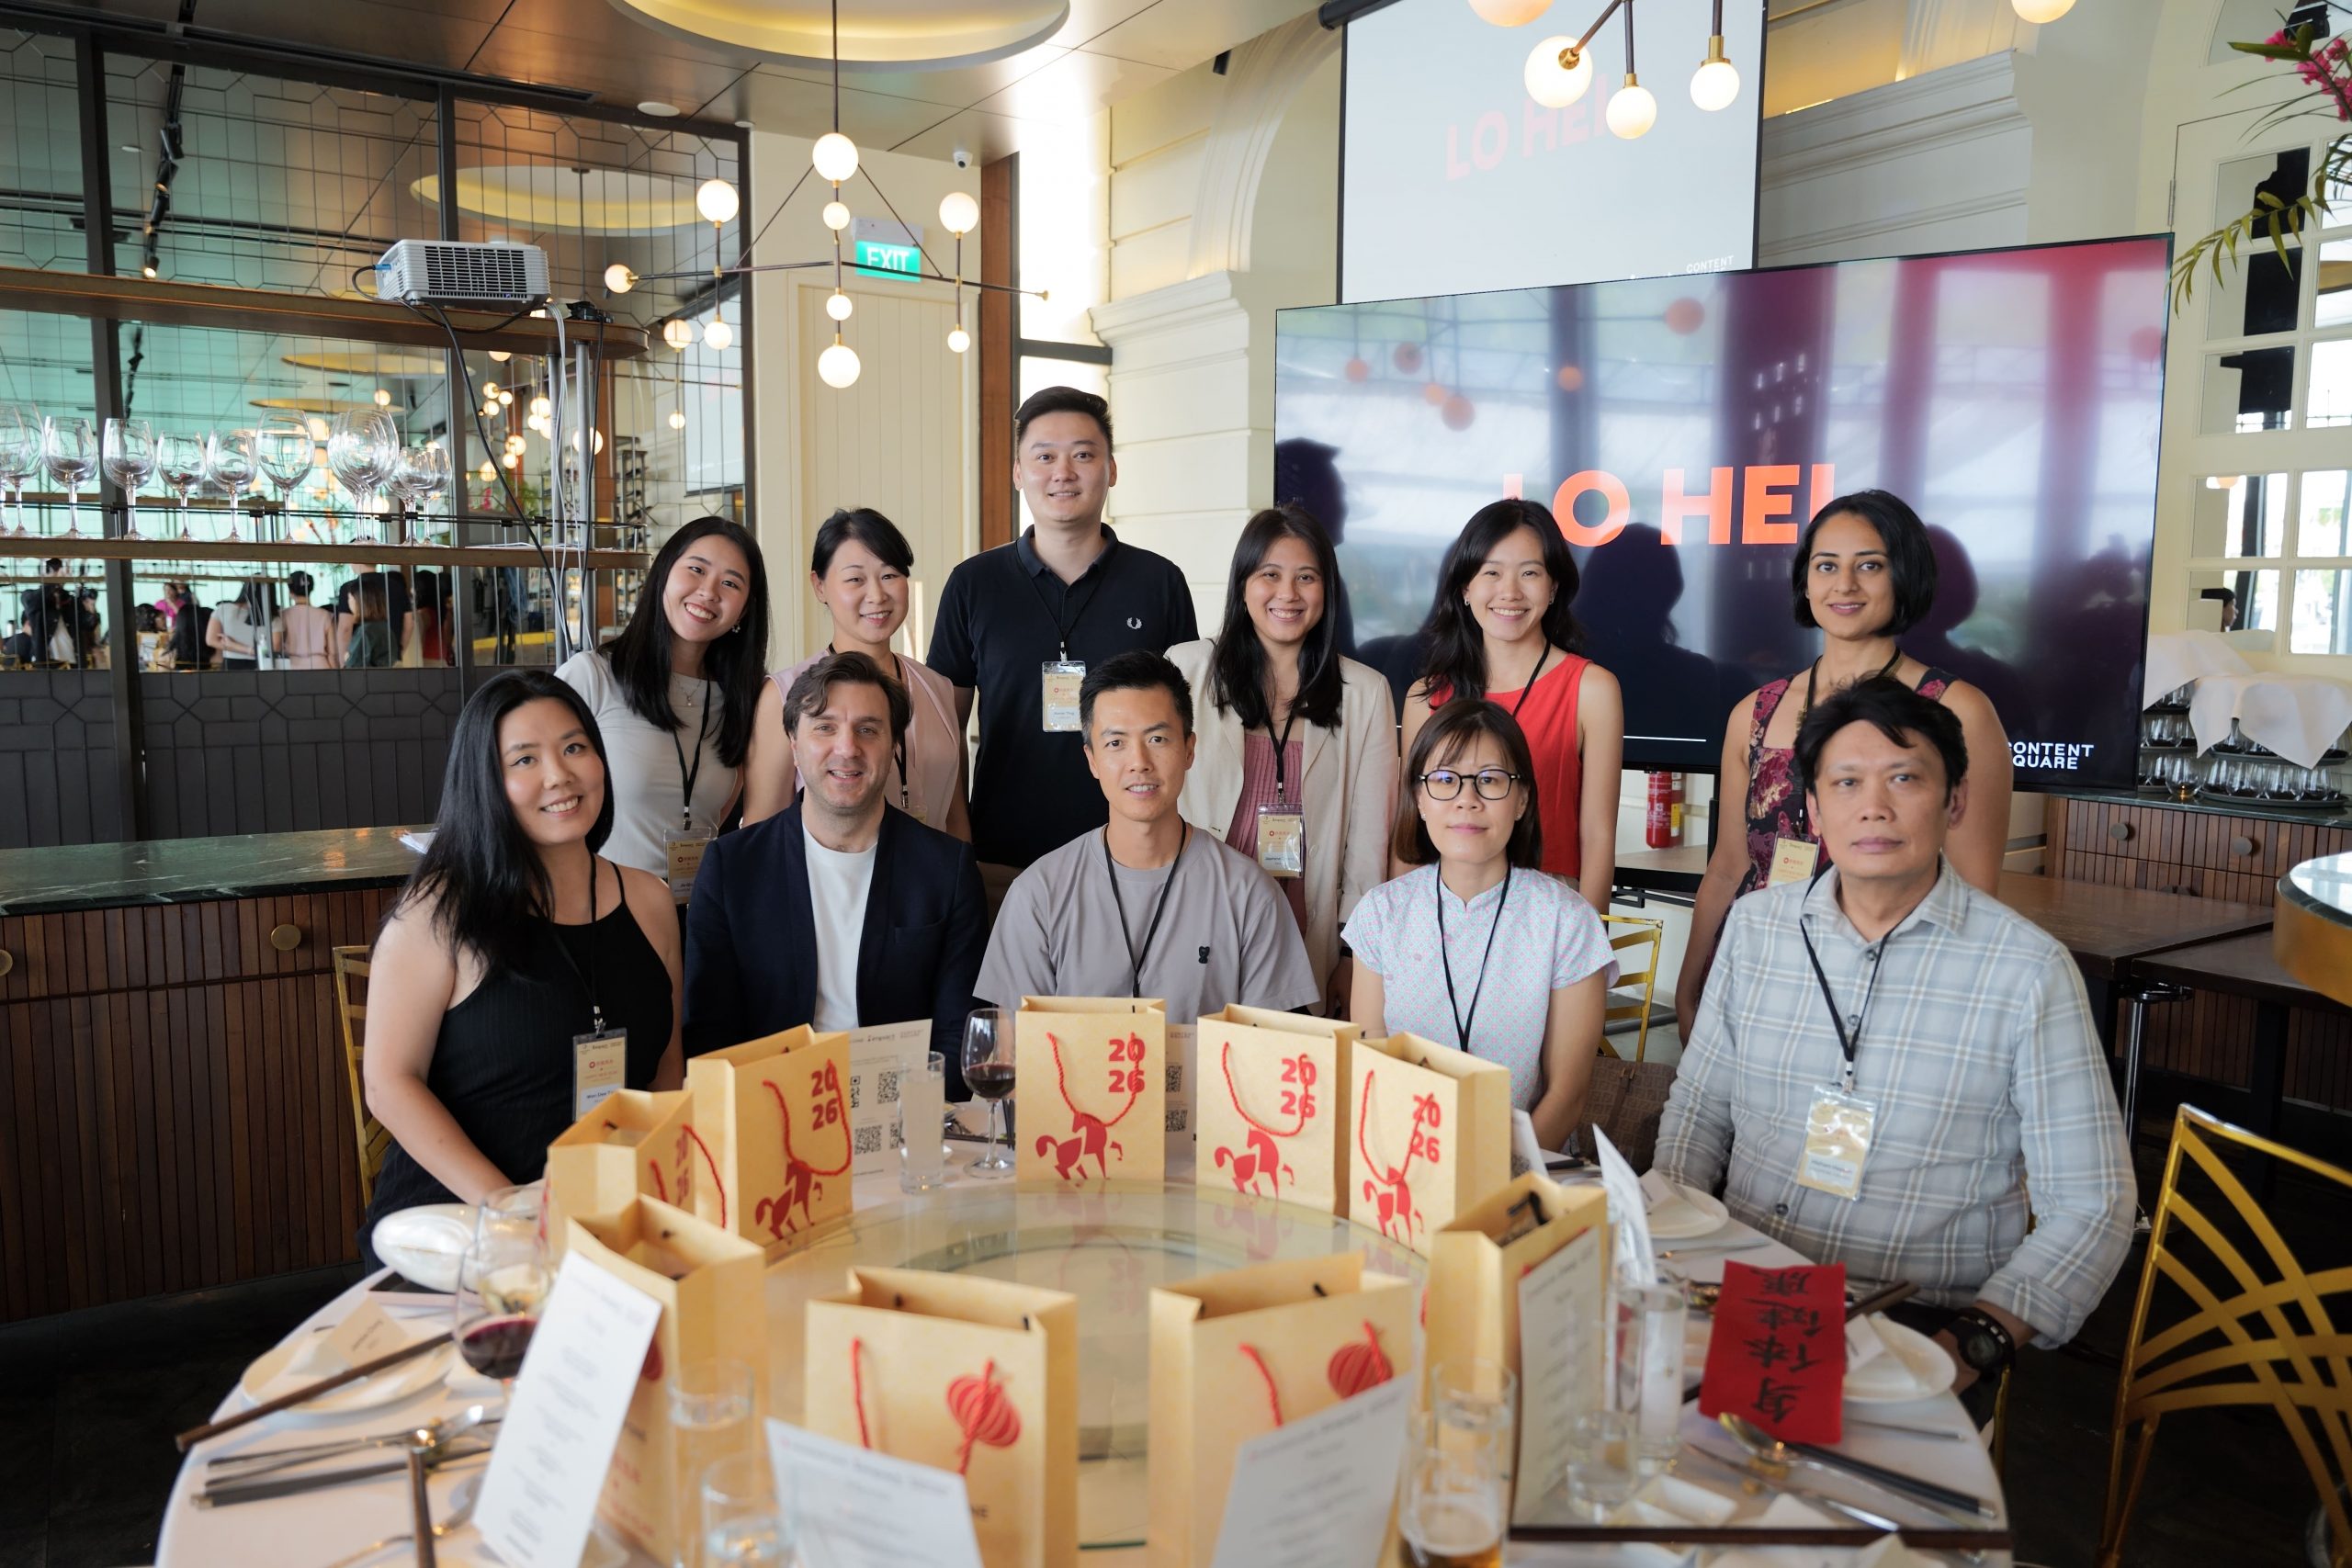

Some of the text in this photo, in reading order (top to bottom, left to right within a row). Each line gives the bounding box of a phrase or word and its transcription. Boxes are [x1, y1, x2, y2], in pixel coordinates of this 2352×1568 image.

[1445, 109, 1509, 180] LO
[866, 246, 910, 272] EXIT
[1686, 255, 1735, 274] CONTENT
[2012, 755, 2078, 770] QUARE
[1109, 1038, 1145, 1062] 20
[811, 1066, 838, 1098] 20
[1108, 1070, 1145, 1093] 26
[1281, 1058, 1317, 1085] 20
[812, 1098, 839, 1132] 26
[1281, 1090, 1316, 1118] 26
[1410, 1131, 1440, 1163] 26
